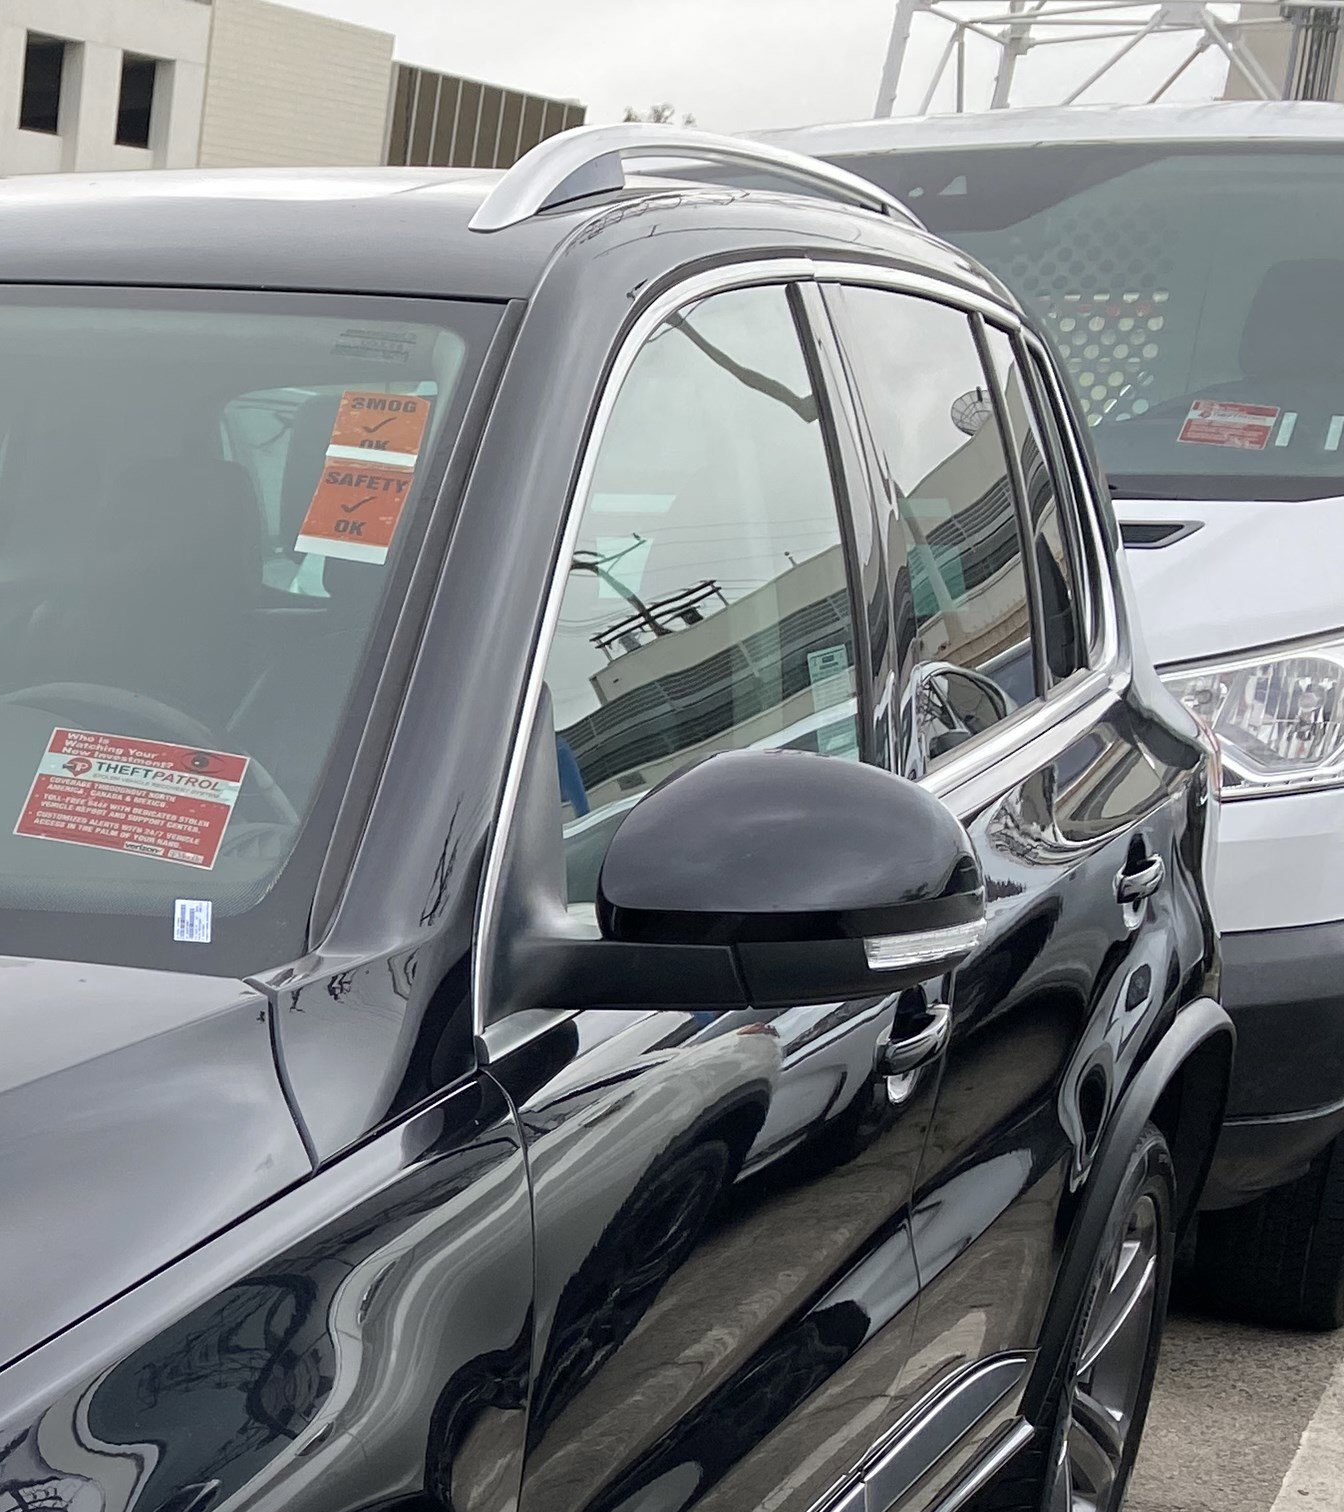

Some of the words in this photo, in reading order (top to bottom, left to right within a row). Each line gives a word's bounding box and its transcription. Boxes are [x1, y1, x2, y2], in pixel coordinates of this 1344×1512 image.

[351, 397, 417, 413] SMOG
[359, 438, 390, 451] OK
[325, 471, 409, 493] SAFETY
[334, 519, 367, 536] OK
[67, 732, 94, 742] Who
[99, 736, 109, 744] is
[65, 739, 124, 754] Watching
[128, 748, 159, 759] Your
[62, 747, 91, 756] New
[94, 751, 174, 768] Investment?
[88, 818, 119, 829] ALERTS
[126, 814, 165, 826] SUPPORT
[177, 815, 210, 827] STOLEN
[124, 841, 160, 853] verizon
